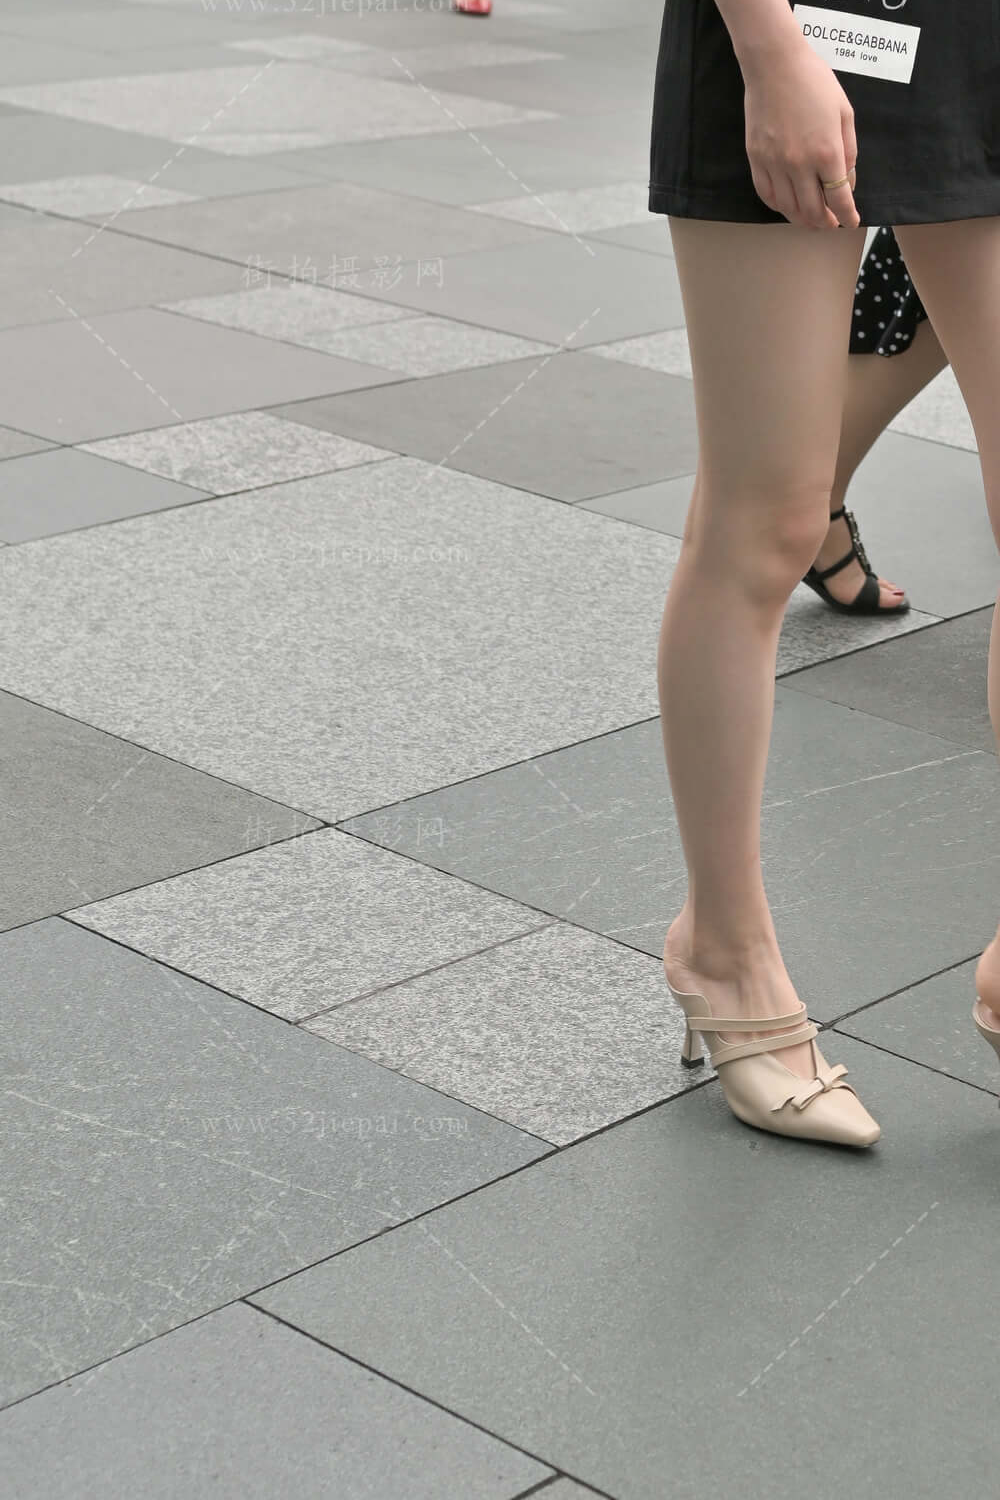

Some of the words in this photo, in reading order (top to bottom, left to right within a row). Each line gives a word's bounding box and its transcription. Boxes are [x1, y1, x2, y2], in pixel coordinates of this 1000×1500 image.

[802, 23, 908, 55] DOLCE&GABBANA
[835, 47, 856, 59] 1984
[860, 51, 878, 63] love
